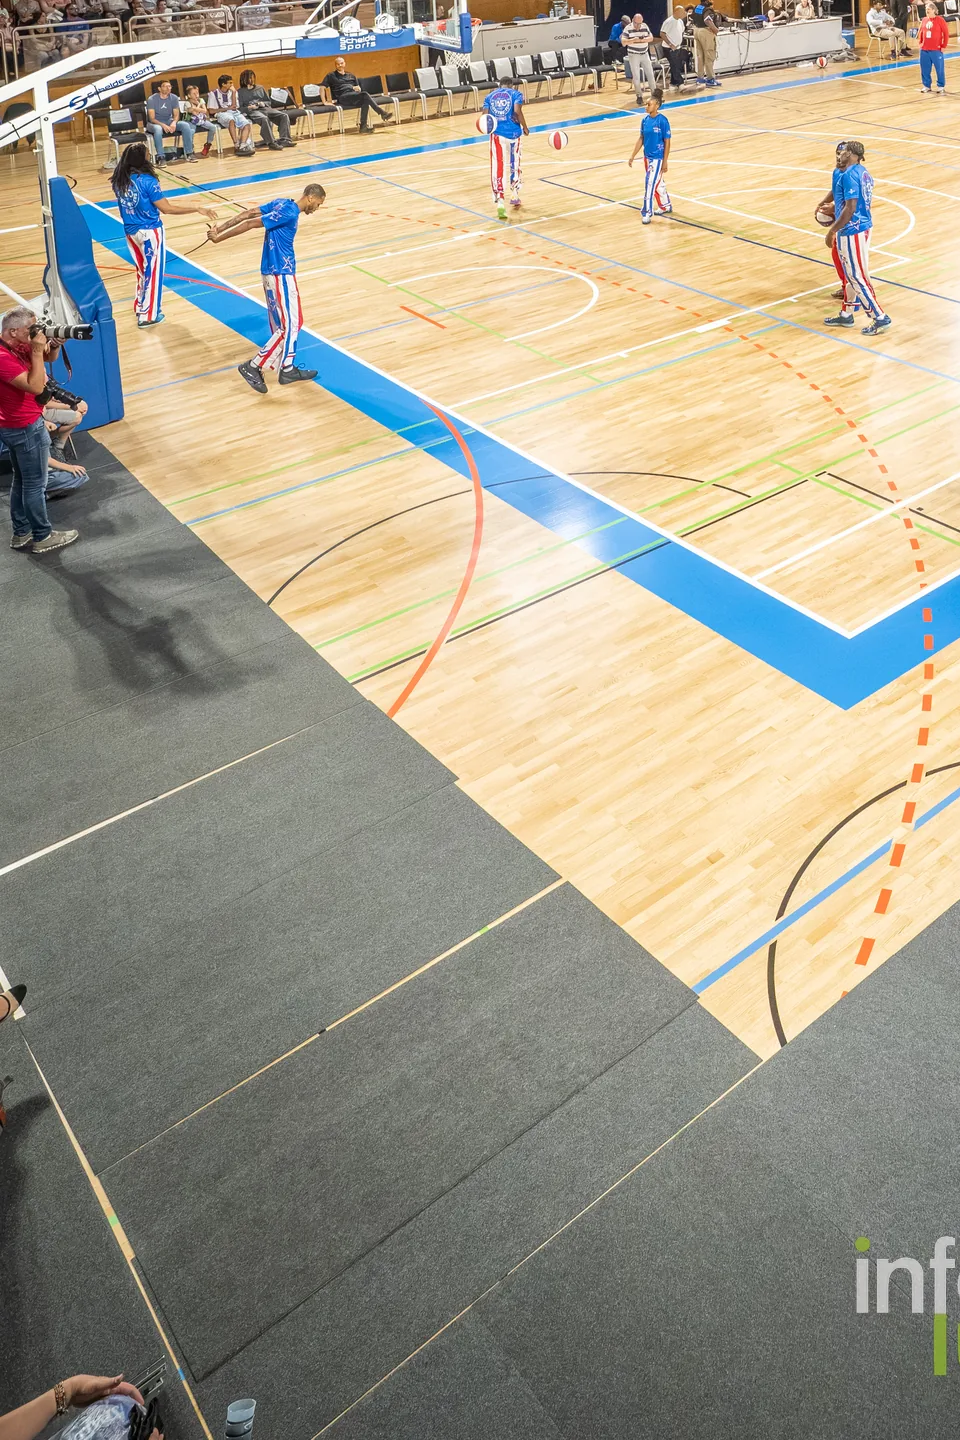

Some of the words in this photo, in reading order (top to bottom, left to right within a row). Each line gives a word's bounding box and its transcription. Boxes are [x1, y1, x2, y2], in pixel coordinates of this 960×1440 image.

[339, 34, 377, 44] Schelde
[553, 33, 582, 41] coque.lu
[339, 41, 377, 52] Sports
